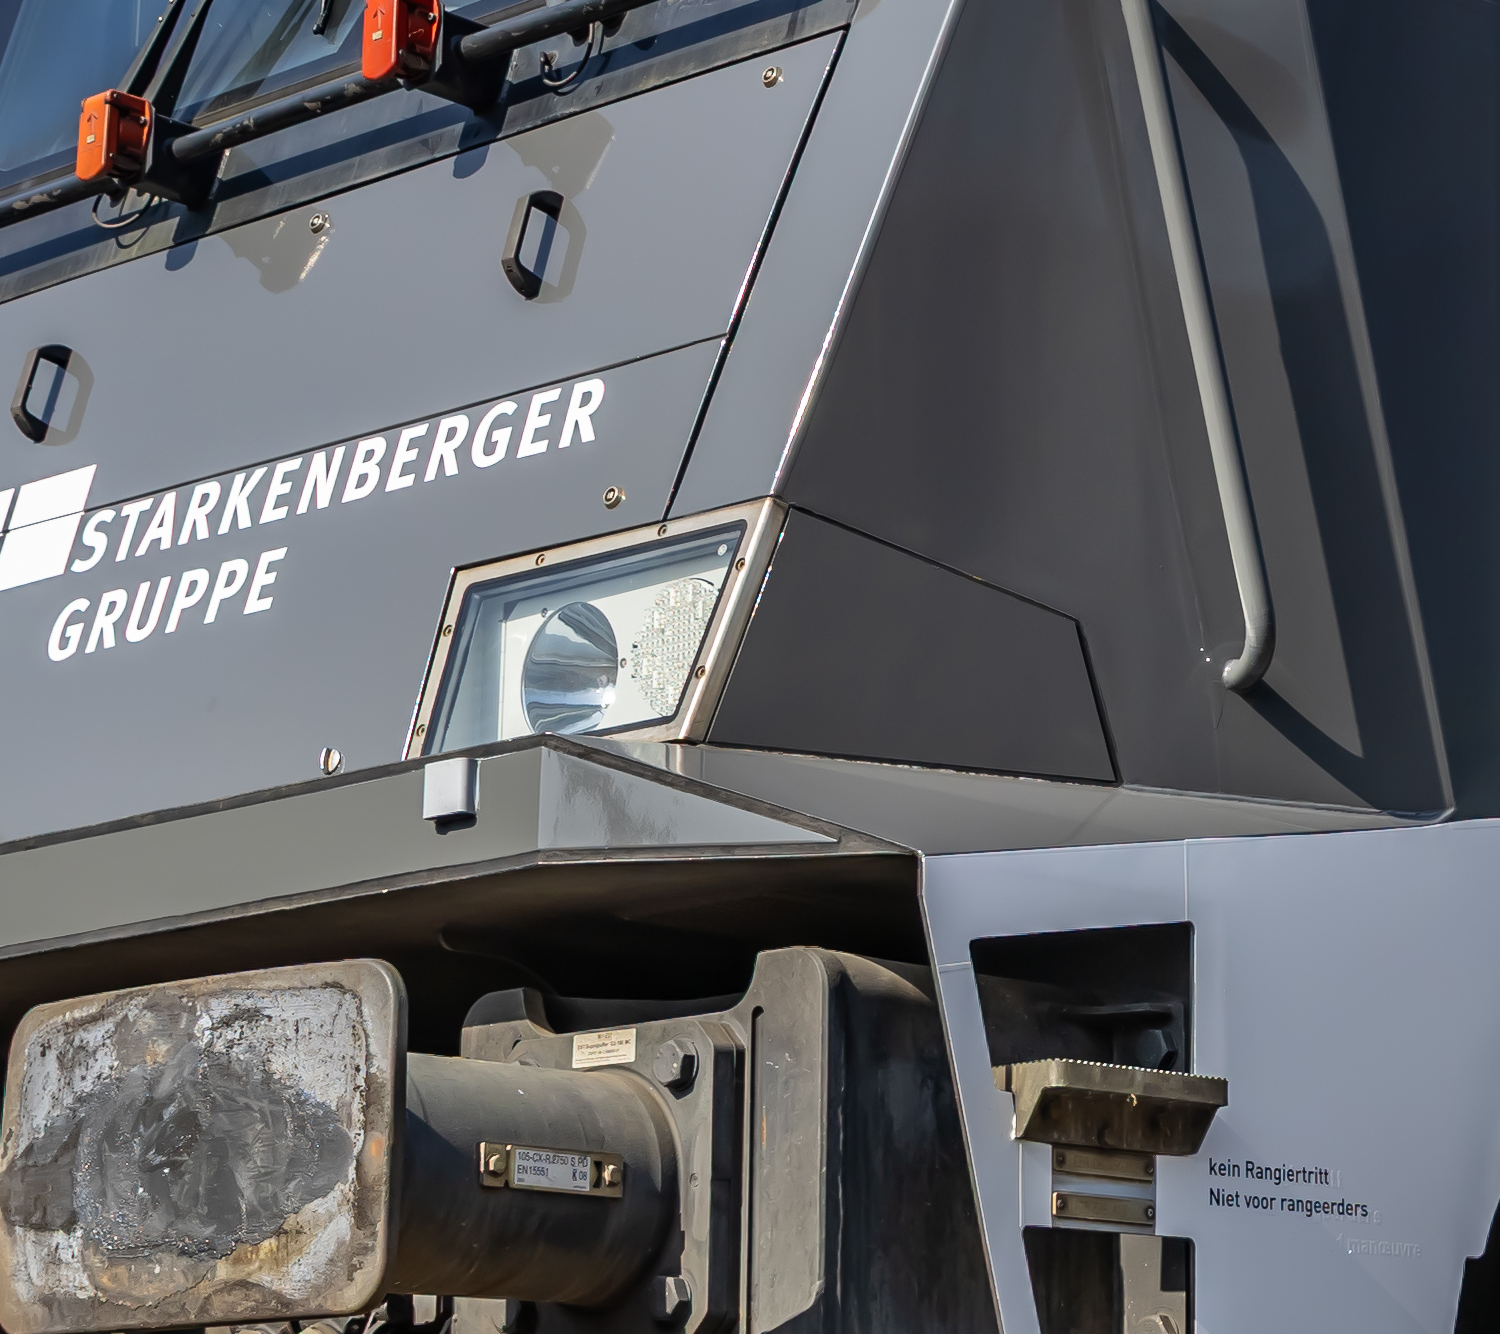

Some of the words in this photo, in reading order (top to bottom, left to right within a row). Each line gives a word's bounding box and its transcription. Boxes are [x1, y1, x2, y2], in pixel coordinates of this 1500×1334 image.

[70, 378, 605, 574] STARKENBERGER
[47, 547, 288, 663] GRUPPE
[1208, 1157, 1241, 1178] kein
[1245, 1160, 1330, 1186] Rangiertritt
[1209, 1188, 1241, 1208] Niet
[1244, 1195, 1276, 1211] voor
[1280, 1198, 1369, 1218] rangeerders
